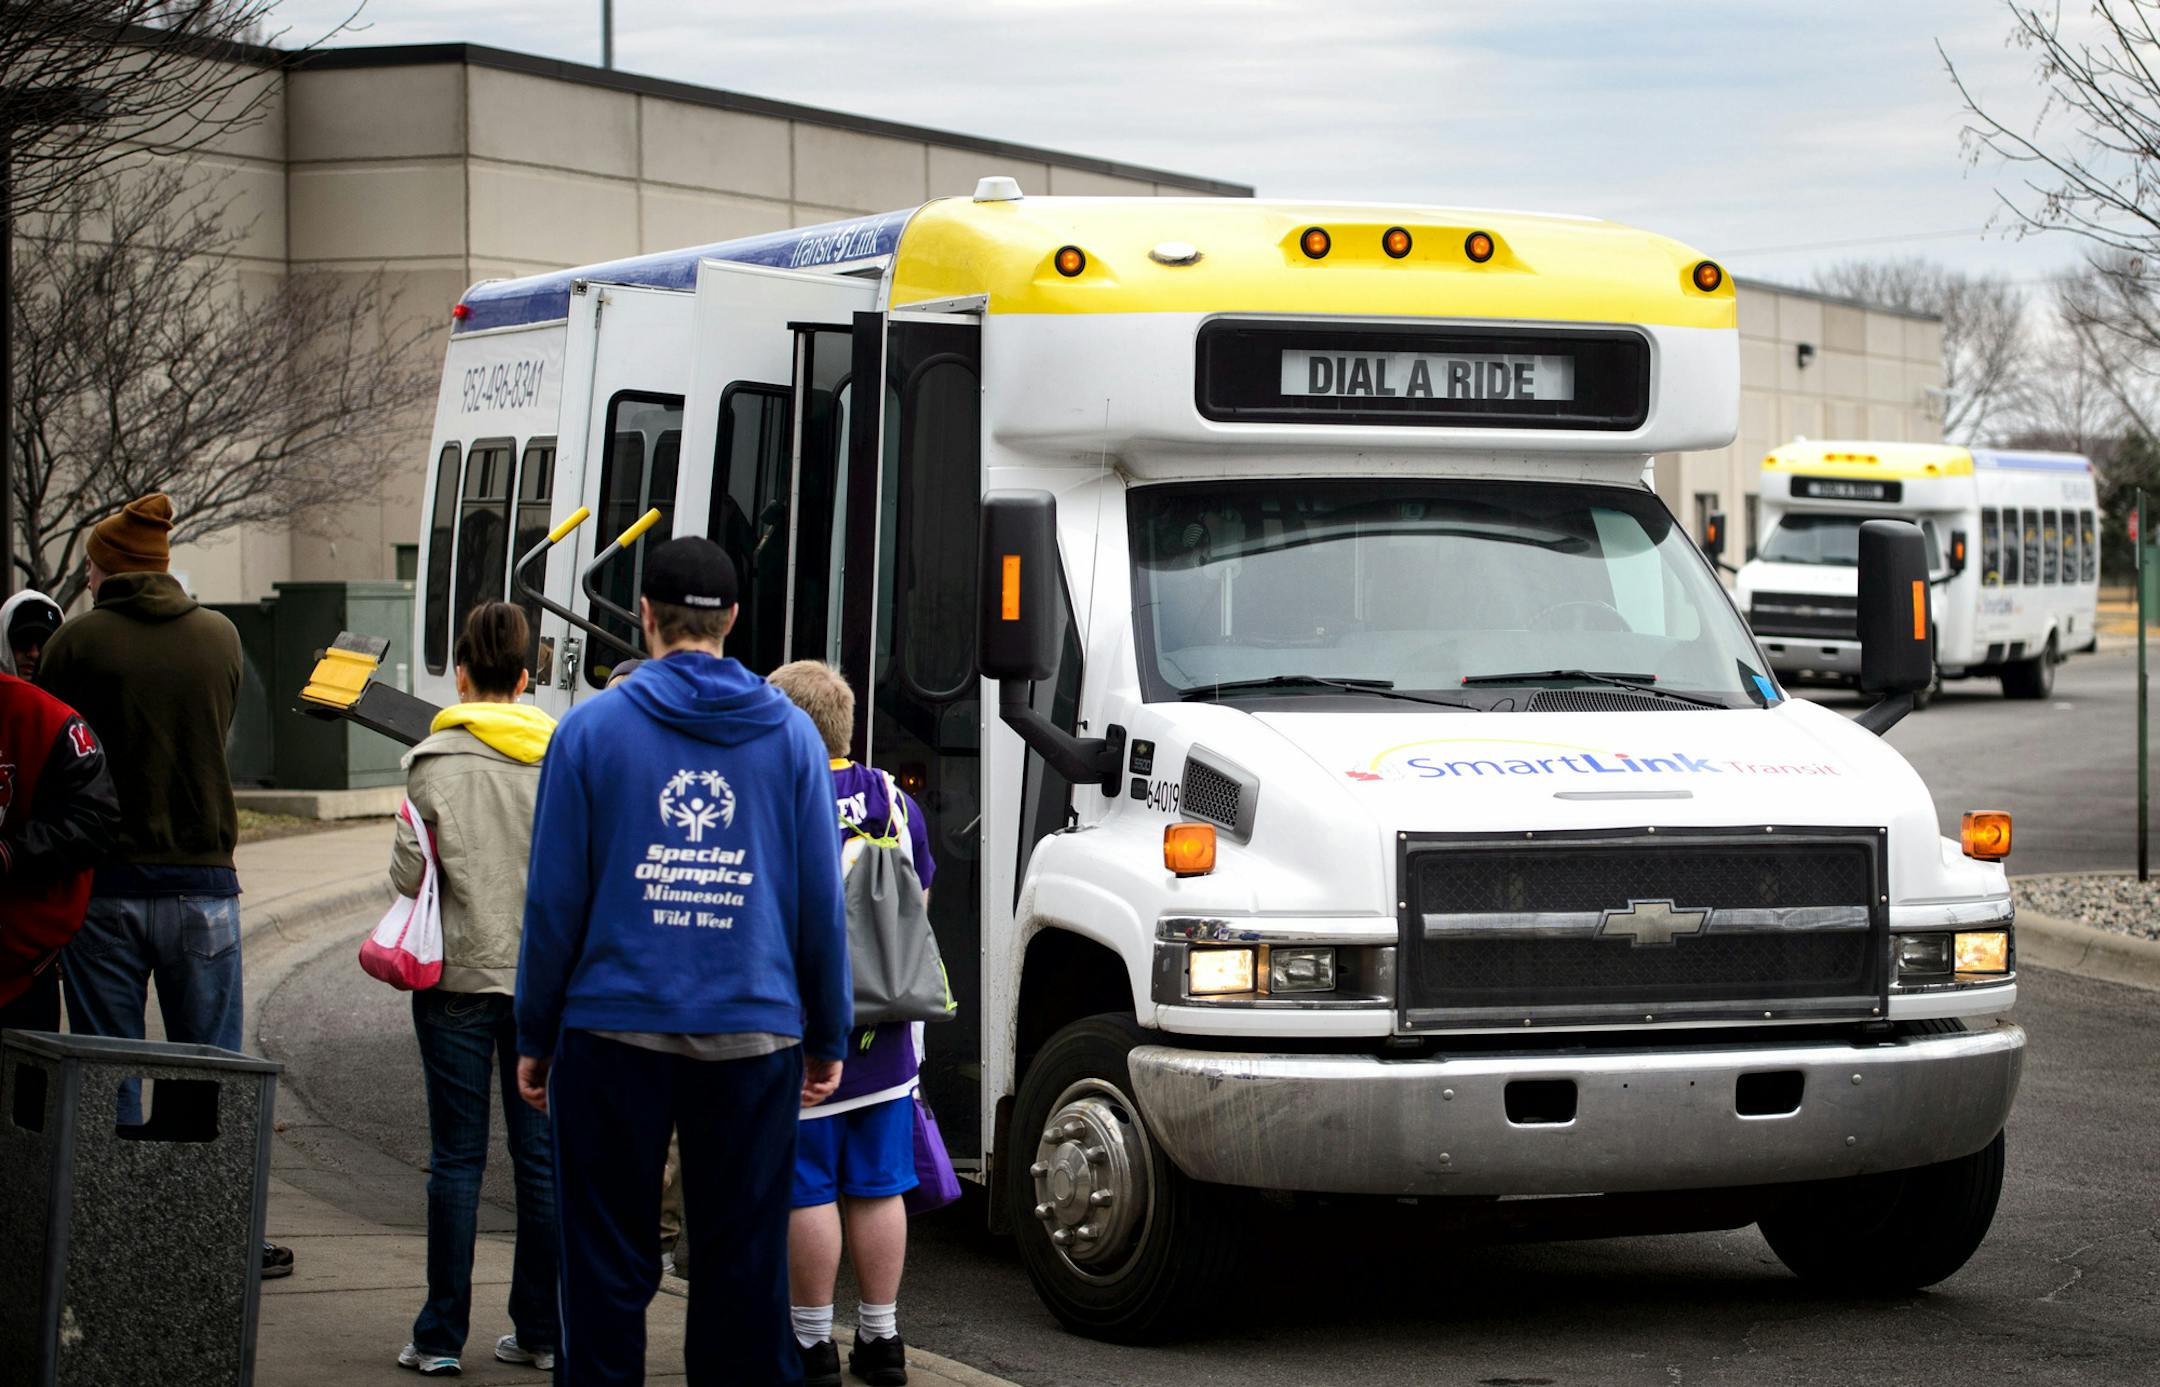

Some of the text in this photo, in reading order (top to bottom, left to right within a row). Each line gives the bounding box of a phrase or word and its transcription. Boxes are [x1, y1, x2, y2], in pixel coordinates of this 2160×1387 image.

[790, 217, 888, 267] Transit Link
[461, 360, 544, 414] 952-496-8341
[1308, 356, 1536, 399] DIAL A RIDE
[1407, 752, 1842, 779] SmartLink Transit
[1147, 780, 1180, 813] 64019
[646, 844, 746, 865] Special
[635, 863, 754, 885] Olympics
[643, 884, 744, 906] Minnesota
[652, 909, 733, 929] Wild West
